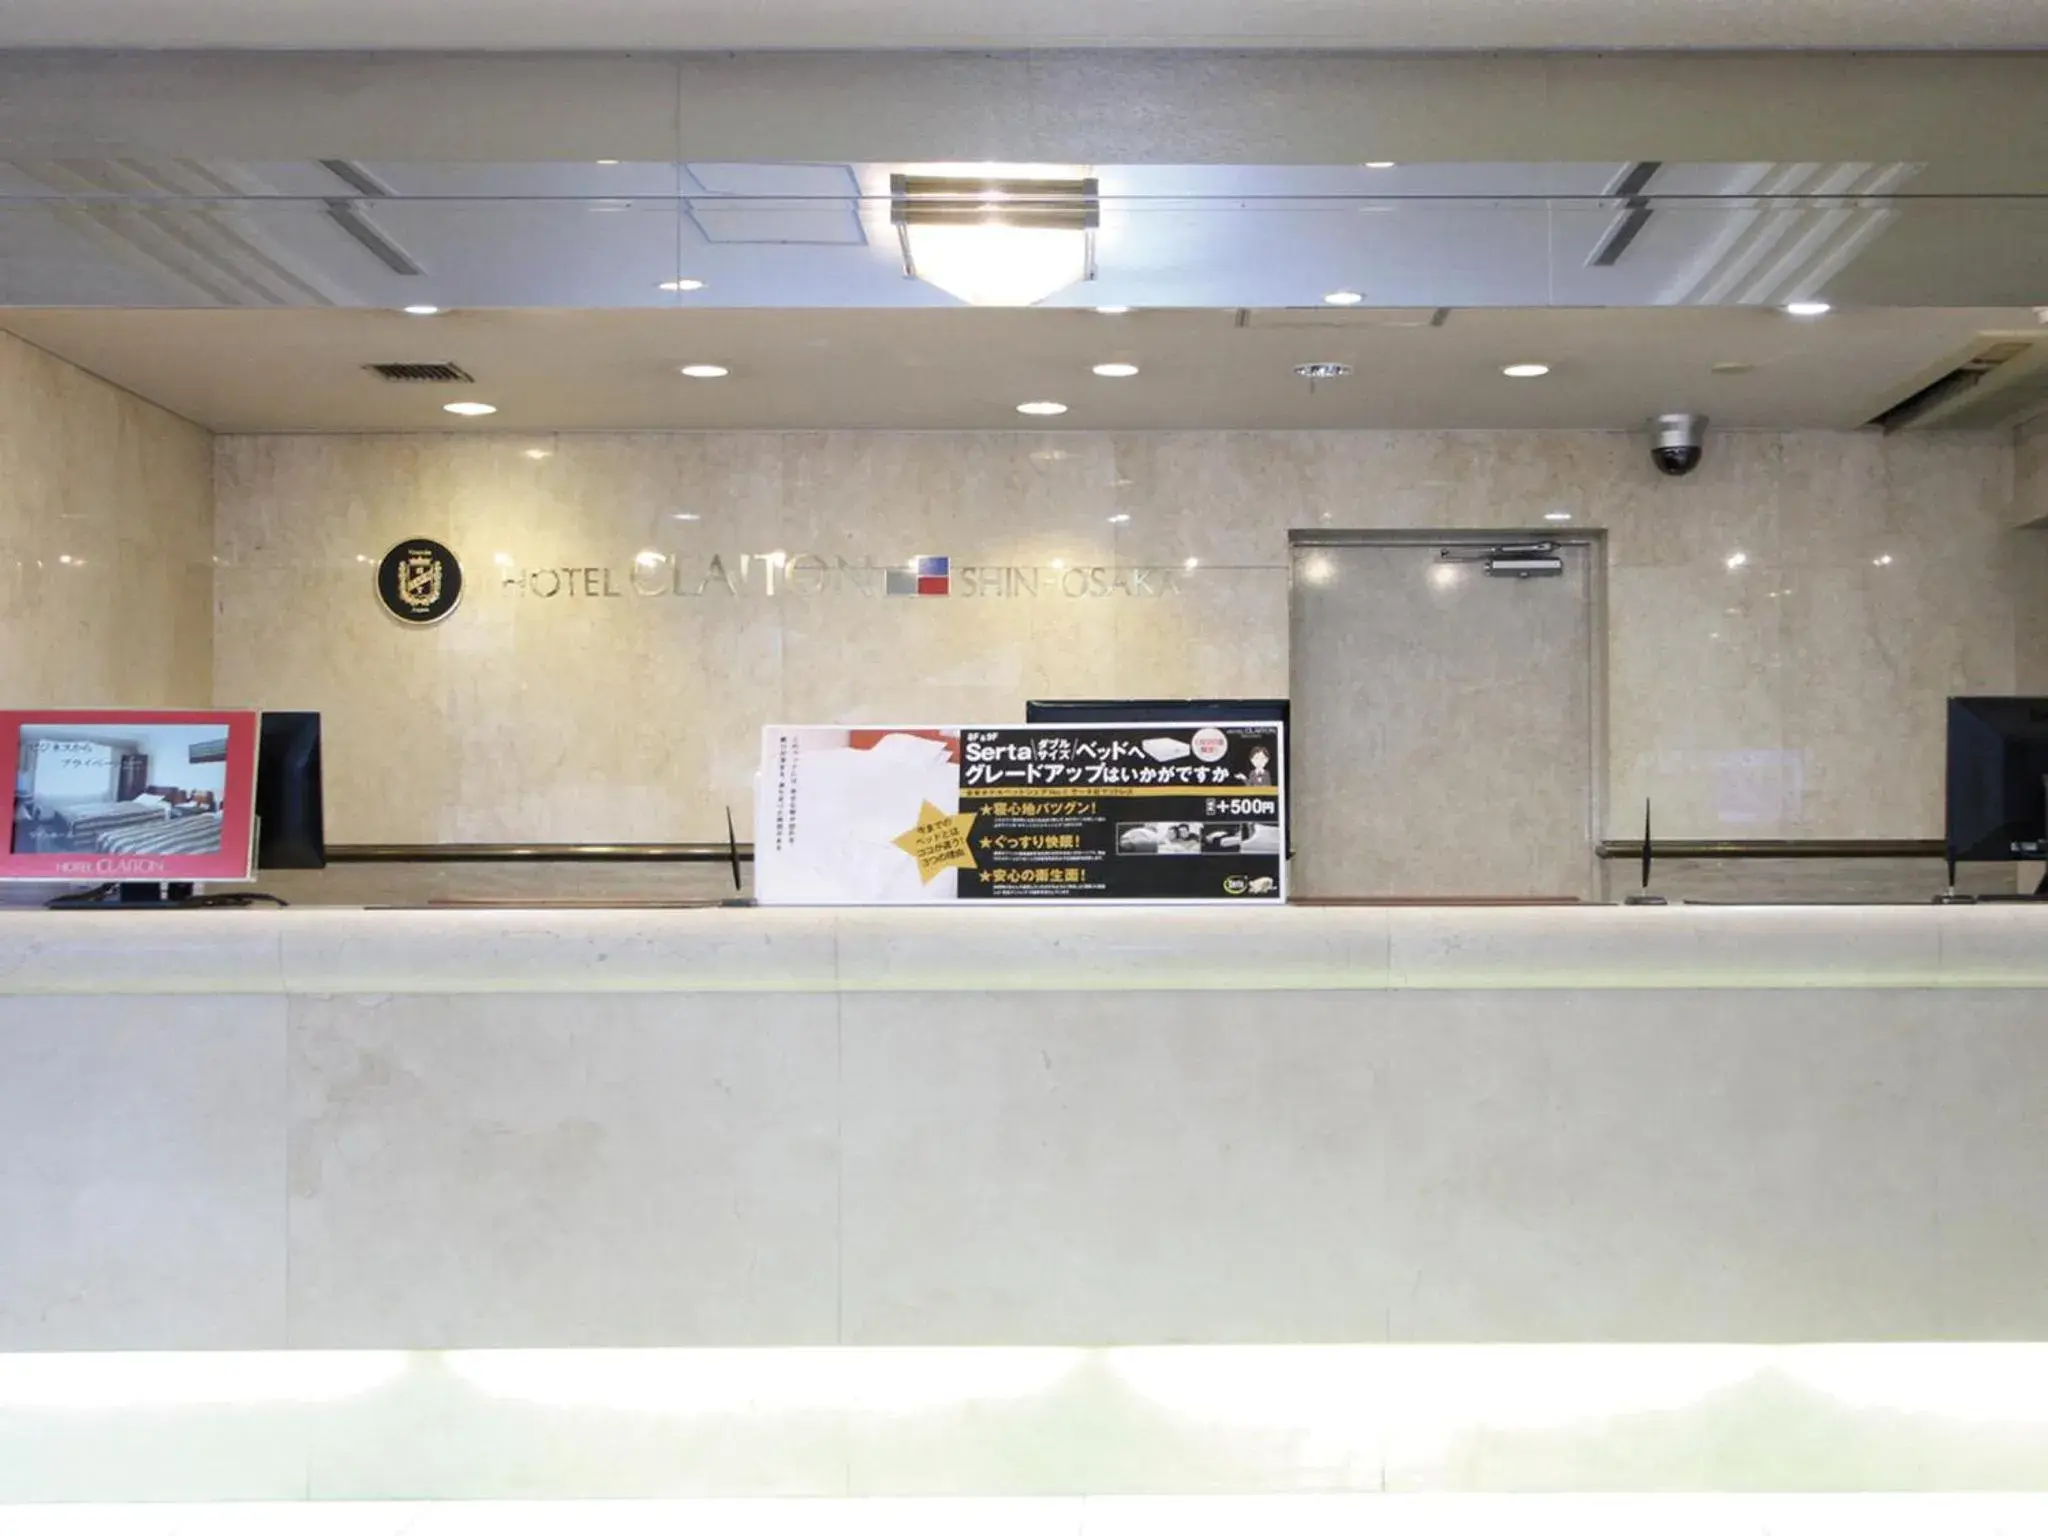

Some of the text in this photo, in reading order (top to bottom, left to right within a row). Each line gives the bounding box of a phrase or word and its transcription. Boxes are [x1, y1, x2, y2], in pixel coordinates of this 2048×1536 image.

[503, 567, 622, 598] HOTEL
[959, 566, 1182, 598] SHIN-OSAKA
[965, 742, 1032, 762] Serta
[1038, 738, 1071, 749] ダブル
[1076, 739, 1145, 761] ベッドへ
[1038, 750, 1071, 761] サイズ
[965, 763, 1230, 785] グレードアップはいかがですか
